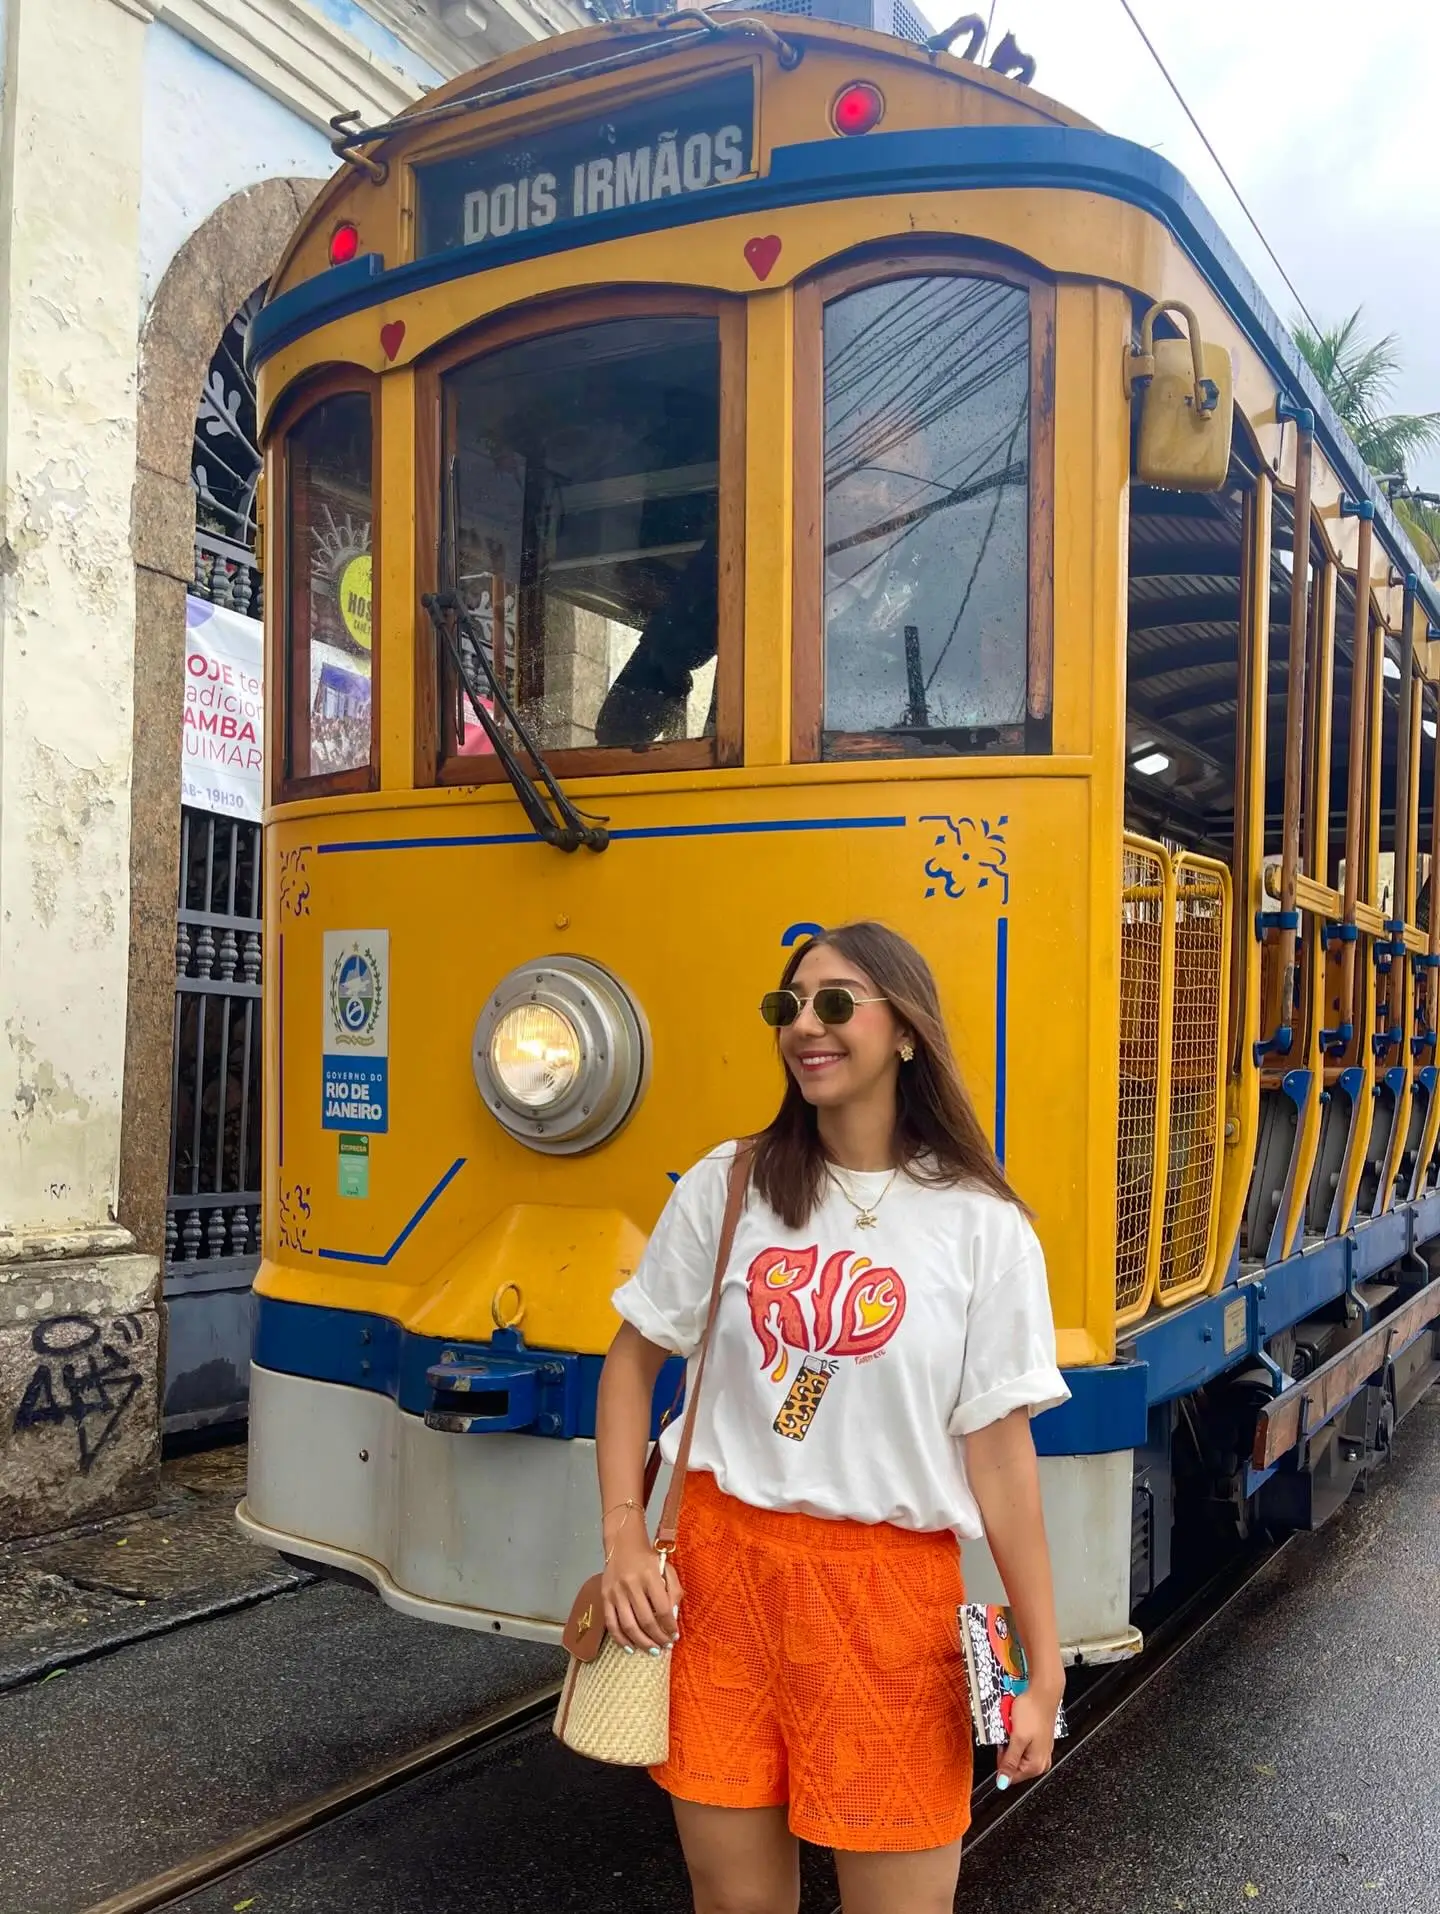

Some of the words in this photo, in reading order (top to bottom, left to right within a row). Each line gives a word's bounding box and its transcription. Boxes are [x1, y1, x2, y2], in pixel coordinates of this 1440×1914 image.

[463, 172, 557, 246] DOIS
[573, 124, 744, 217] IRMÃOS
[348, 591, 372, 621] HOS
[187, 654, 235, 687] OJE
[240, 671, 264, 696] te
[182, 706, 256, 744] AMBA
[185, 732, 263, 772] UIMAR
[326, 1071, 366, 1081] GOVERNO
[370, 1073, 382, 1082] DO
[326, 1082, 348, 1099] RIO
[351, 1083, 370, 1100] DE
[326, 1101, 382, 1120] JANEIRO
[746, 1244, 906, 1370] RIO
